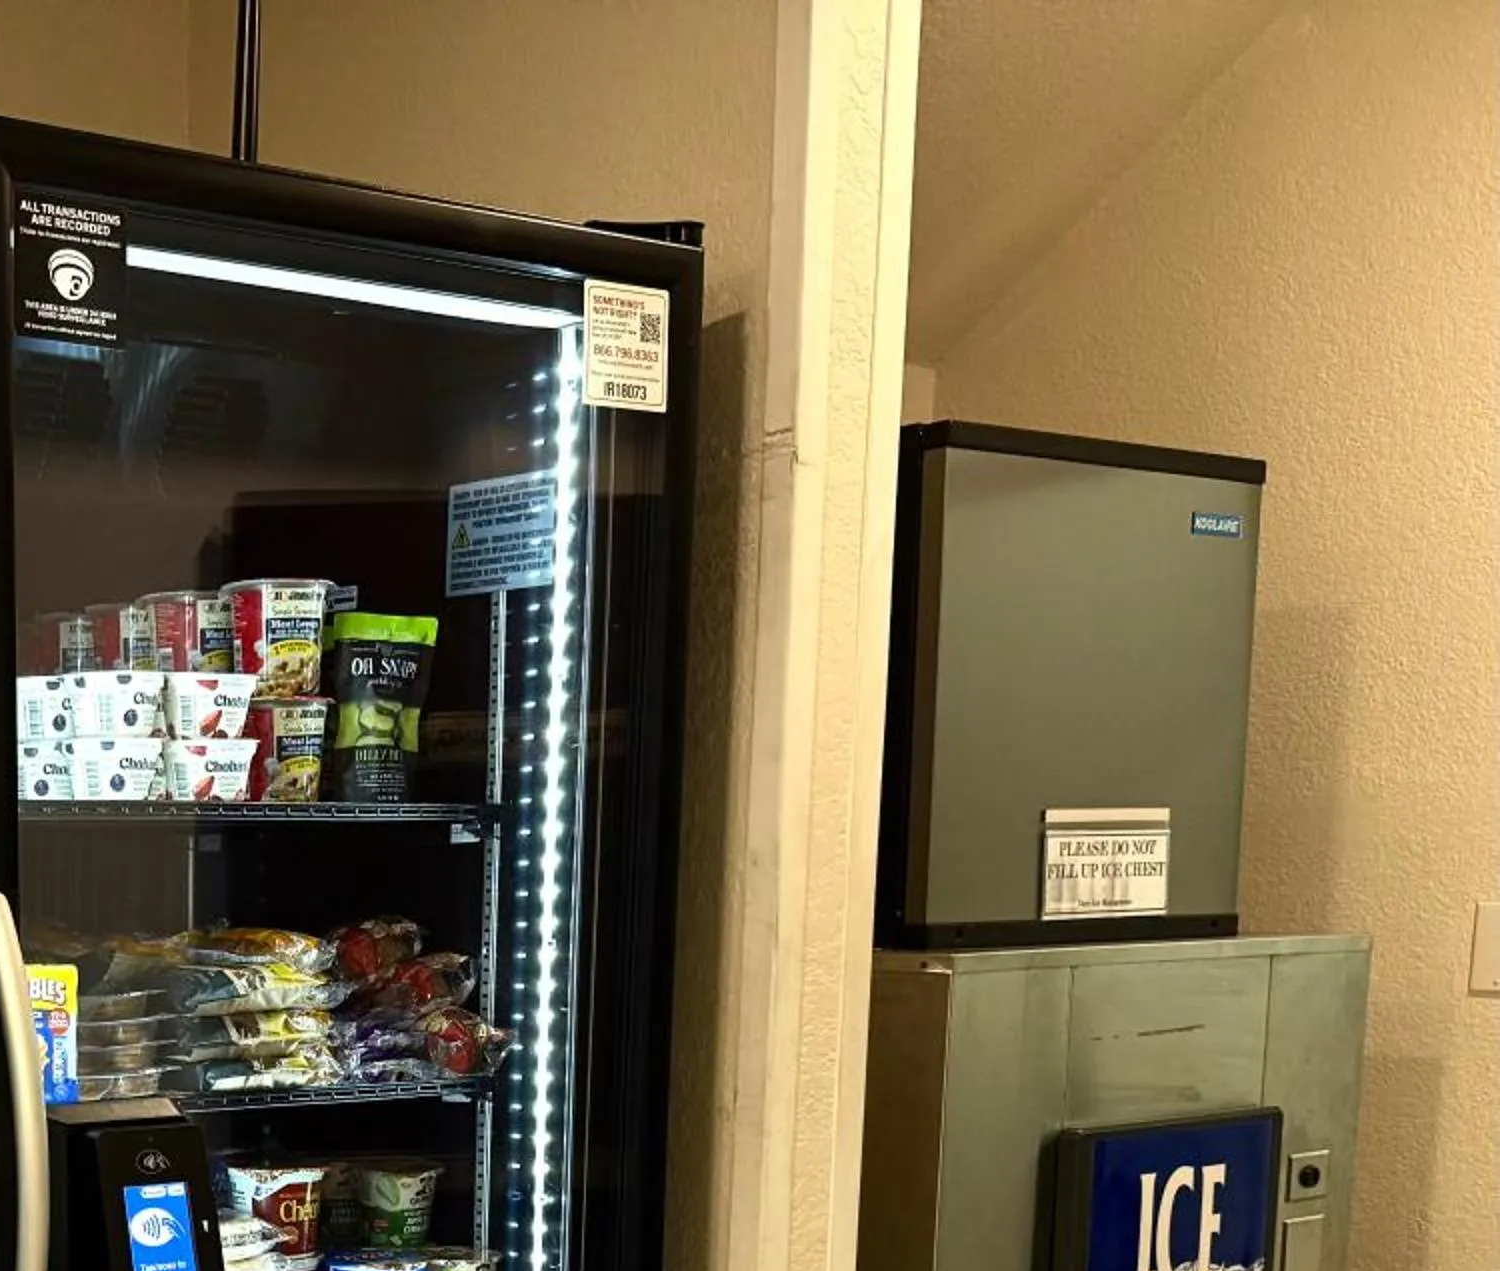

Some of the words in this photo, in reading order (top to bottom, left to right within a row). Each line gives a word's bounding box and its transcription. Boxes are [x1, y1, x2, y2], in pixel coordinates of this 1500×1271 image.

[19, 200, 40, 213] ALL
[41, 203, 121, 226] TRANSACTIONS
[31, 214, 52, 227] ARE
[54, 218, 111, 236] RECORDED
[1059, 840, 1109, 857] PLEASE
[1111, 840, 1129, 857] DO
[1132, 839, 1157, 855] NOT
[1048, 863, 1078, 880] FILL
[1081, 863, 1099, 879] UP
[1101, 862, 1123, 879] ICE
[1125, 861, 1165, 877] CHEST
